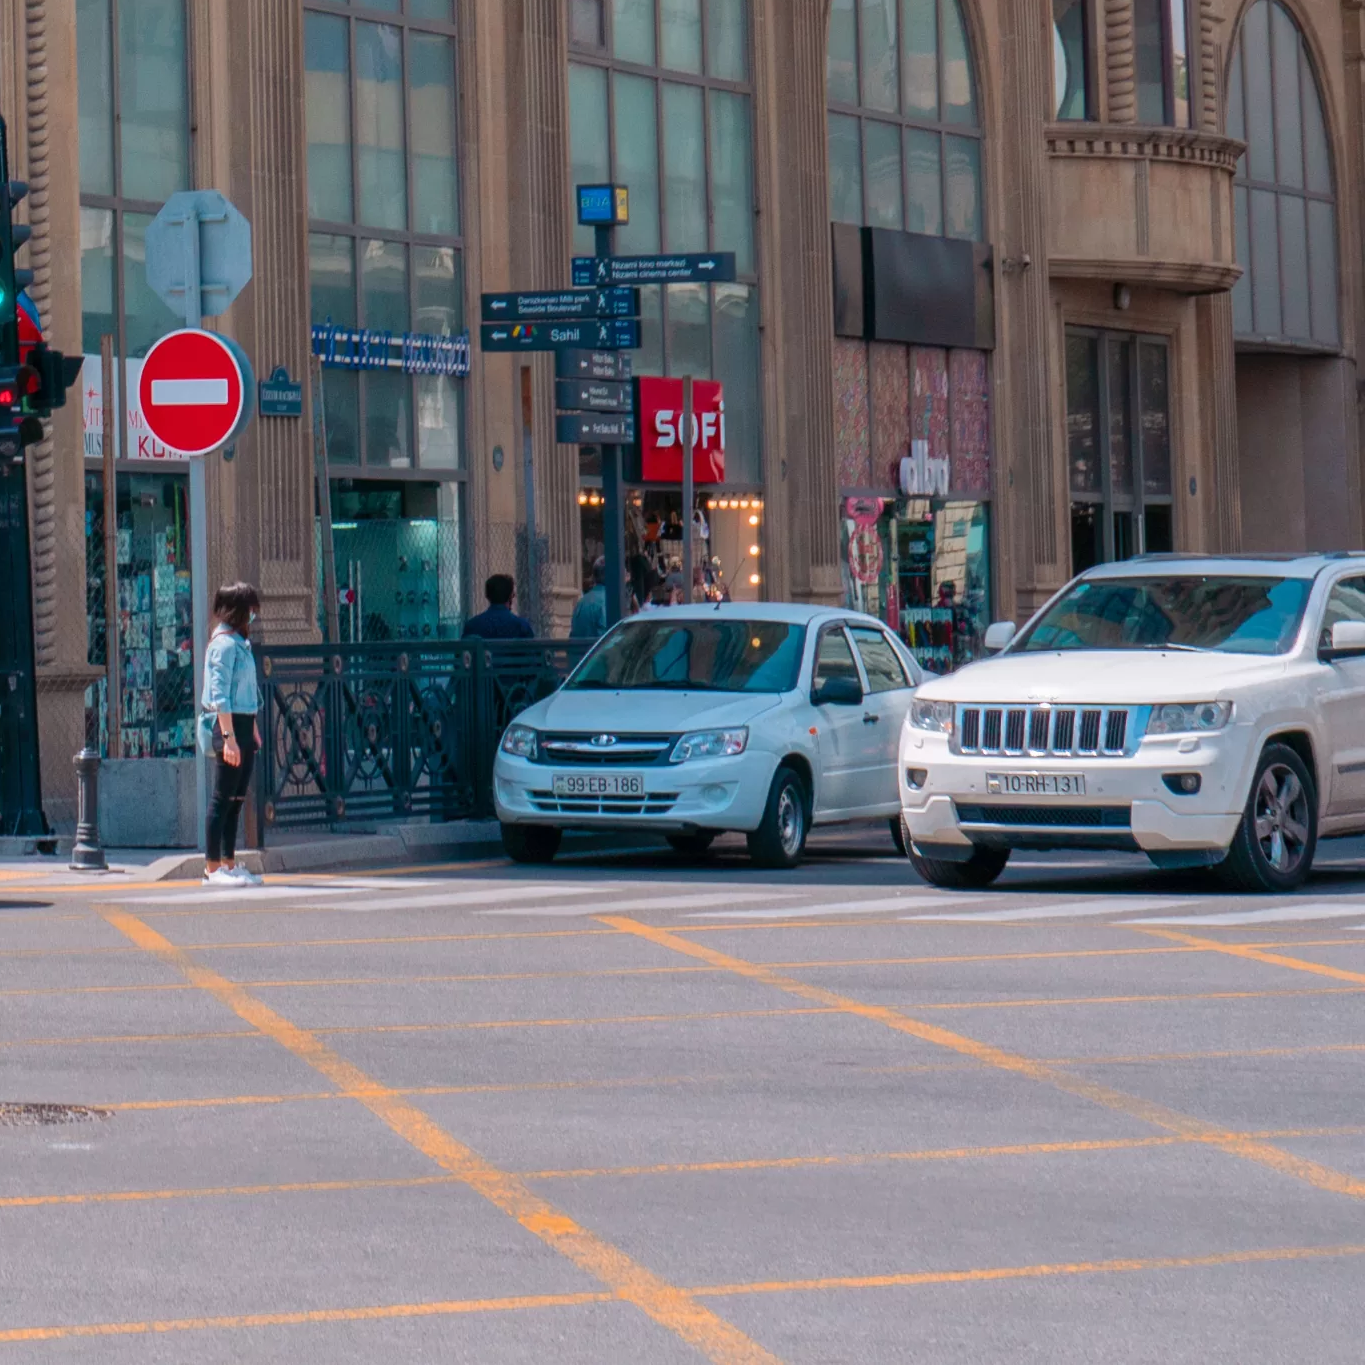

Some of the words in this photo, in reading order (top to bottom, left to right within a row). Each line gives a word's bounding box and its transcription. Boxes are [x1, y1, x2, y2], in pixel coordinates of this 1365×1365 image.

[550, 329, 580, 342] Sahil
[566, 777, 640, 793] 99-EB-186
[1004, 775, 1080, 793] 10-RH-131
